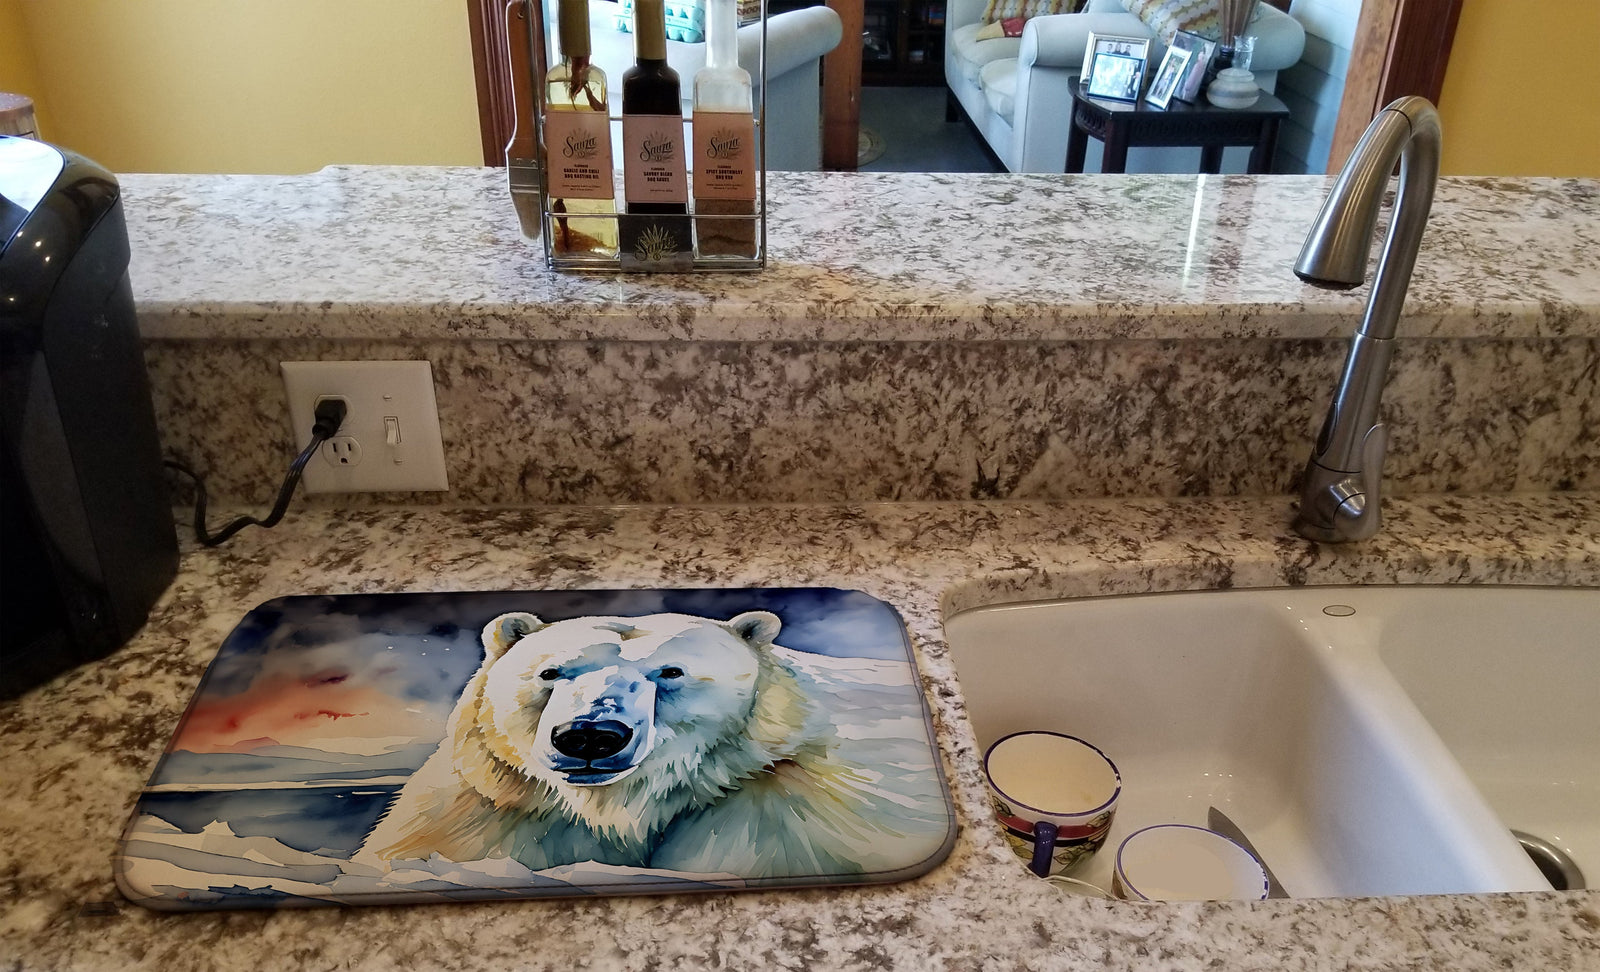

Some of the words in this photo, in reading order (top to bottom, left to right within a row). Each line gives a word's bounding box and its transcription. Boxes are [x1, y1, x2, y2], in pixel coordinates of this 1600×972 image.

[562, 136, 598, 158] Sauza
[639, 140, 674, 161] Sauza
[706, 136, 741, 158] Sauza
